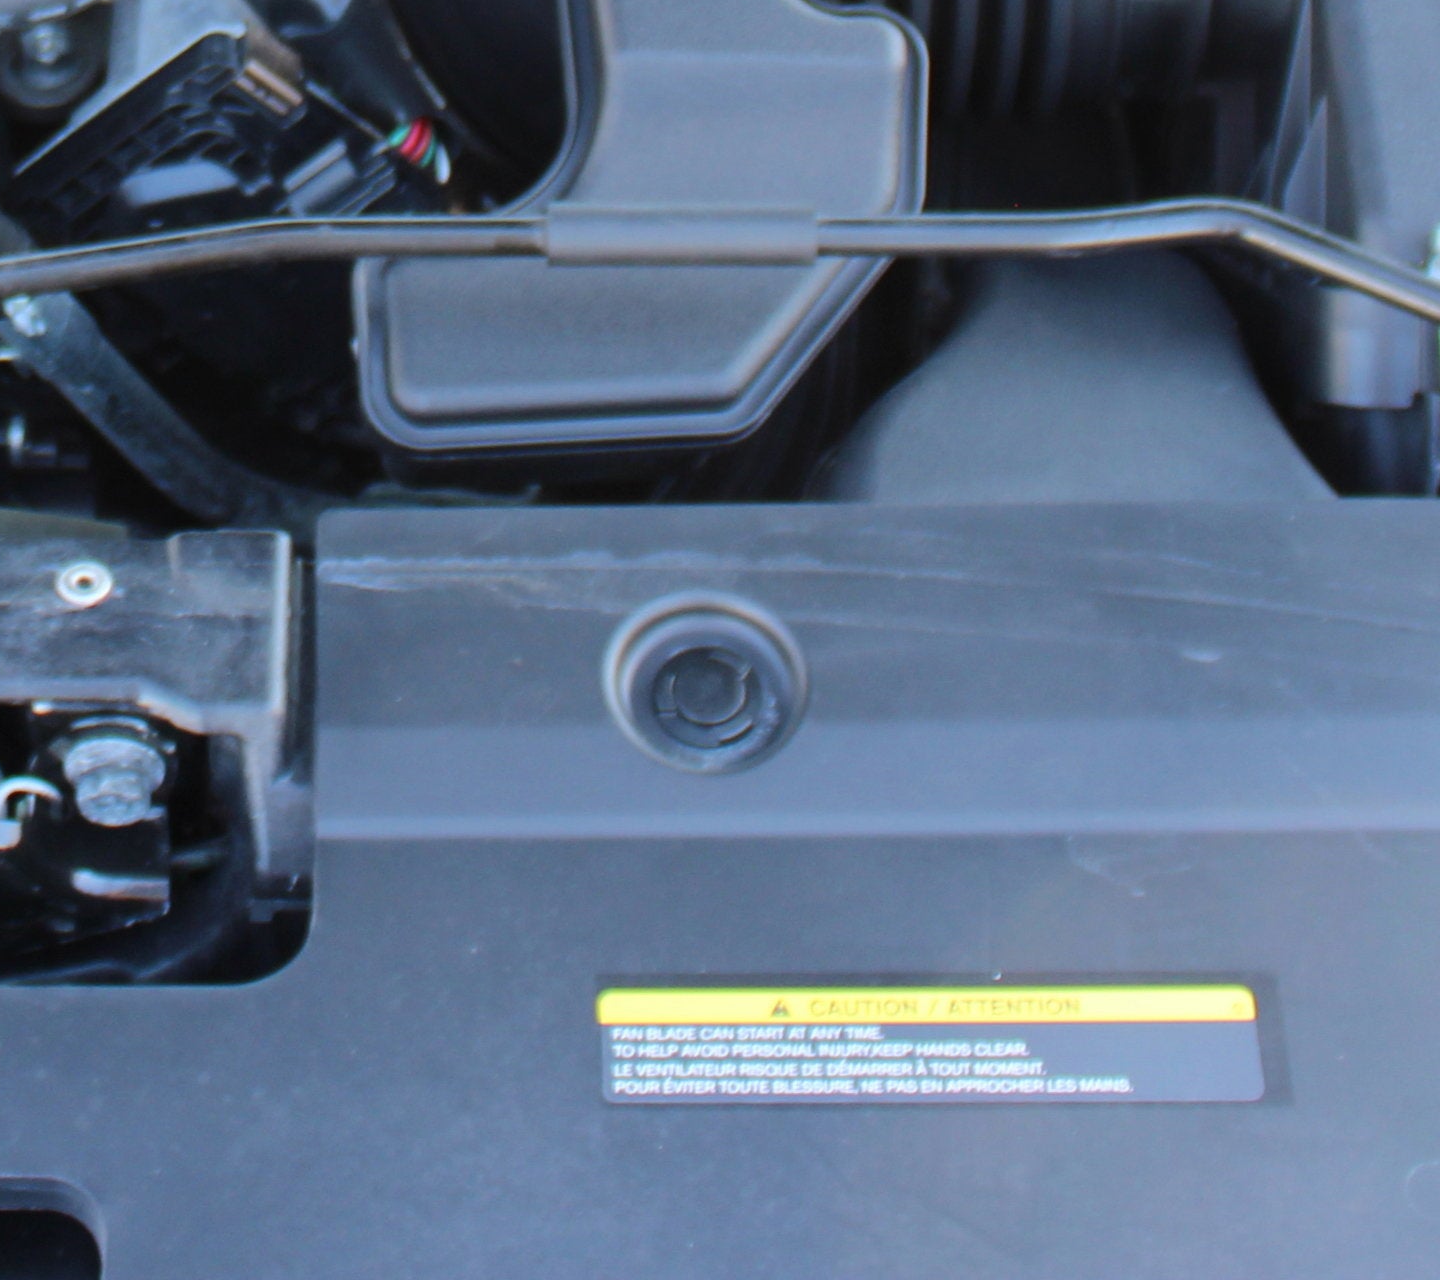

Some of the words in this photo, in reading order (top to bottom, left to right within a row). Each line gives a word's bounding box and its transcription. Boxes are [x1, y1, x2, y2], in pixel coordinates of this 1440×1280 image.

[809, 998, 919, 1017] CAUTION
[948, 998, 1081, 1016] ATTENTION
[612, 1026, 643, 1040] FAN
[645, 1026, 697, 1040] BLADE
[700, 1026, 734, 1040] CAN
[736, 1026, 785, 1040] START
[787, 1026, 807, 1040] AT
[810, 1026, 844, 1040] ANY
[612, 1042, 635, 1058] TO
[638, 1042, 679, 1058] HELP
[681, 1042, 730, 1058] AVOID
[731, 1042, 816, 1058] PERSONAL
[915, 1042, 972, 1058] HANDS
[973, 1042, 1030, 1058] CLEAR.
[614, 1061, 633, 1077] LE
[635, 1061, 737, 1077] VENTILATEUR
[739, 1061, 799, 1077] RISQUE
[801, 1061, 824, 1077] DE
[826, 1058, 913, 1077] DÉMARRER
[929, 1061, 971, 1077] TOUT
[972, 1061, 1047, 1077] MOMENT.
[614, 1079, 661, 1094] POUR
[662, 1075, 716, 1094] ÉVITER
[719, 1079, 770, 1094] TOUTE
[860, 1079, 884, 1094] NE
[885, 1079, 918, 1094] PAS
[920, 1079, 943, 1094] EN
[945, 1079, 1044, 1094] APPROCHER
[1046, 1079, 1078, 1094] LES
